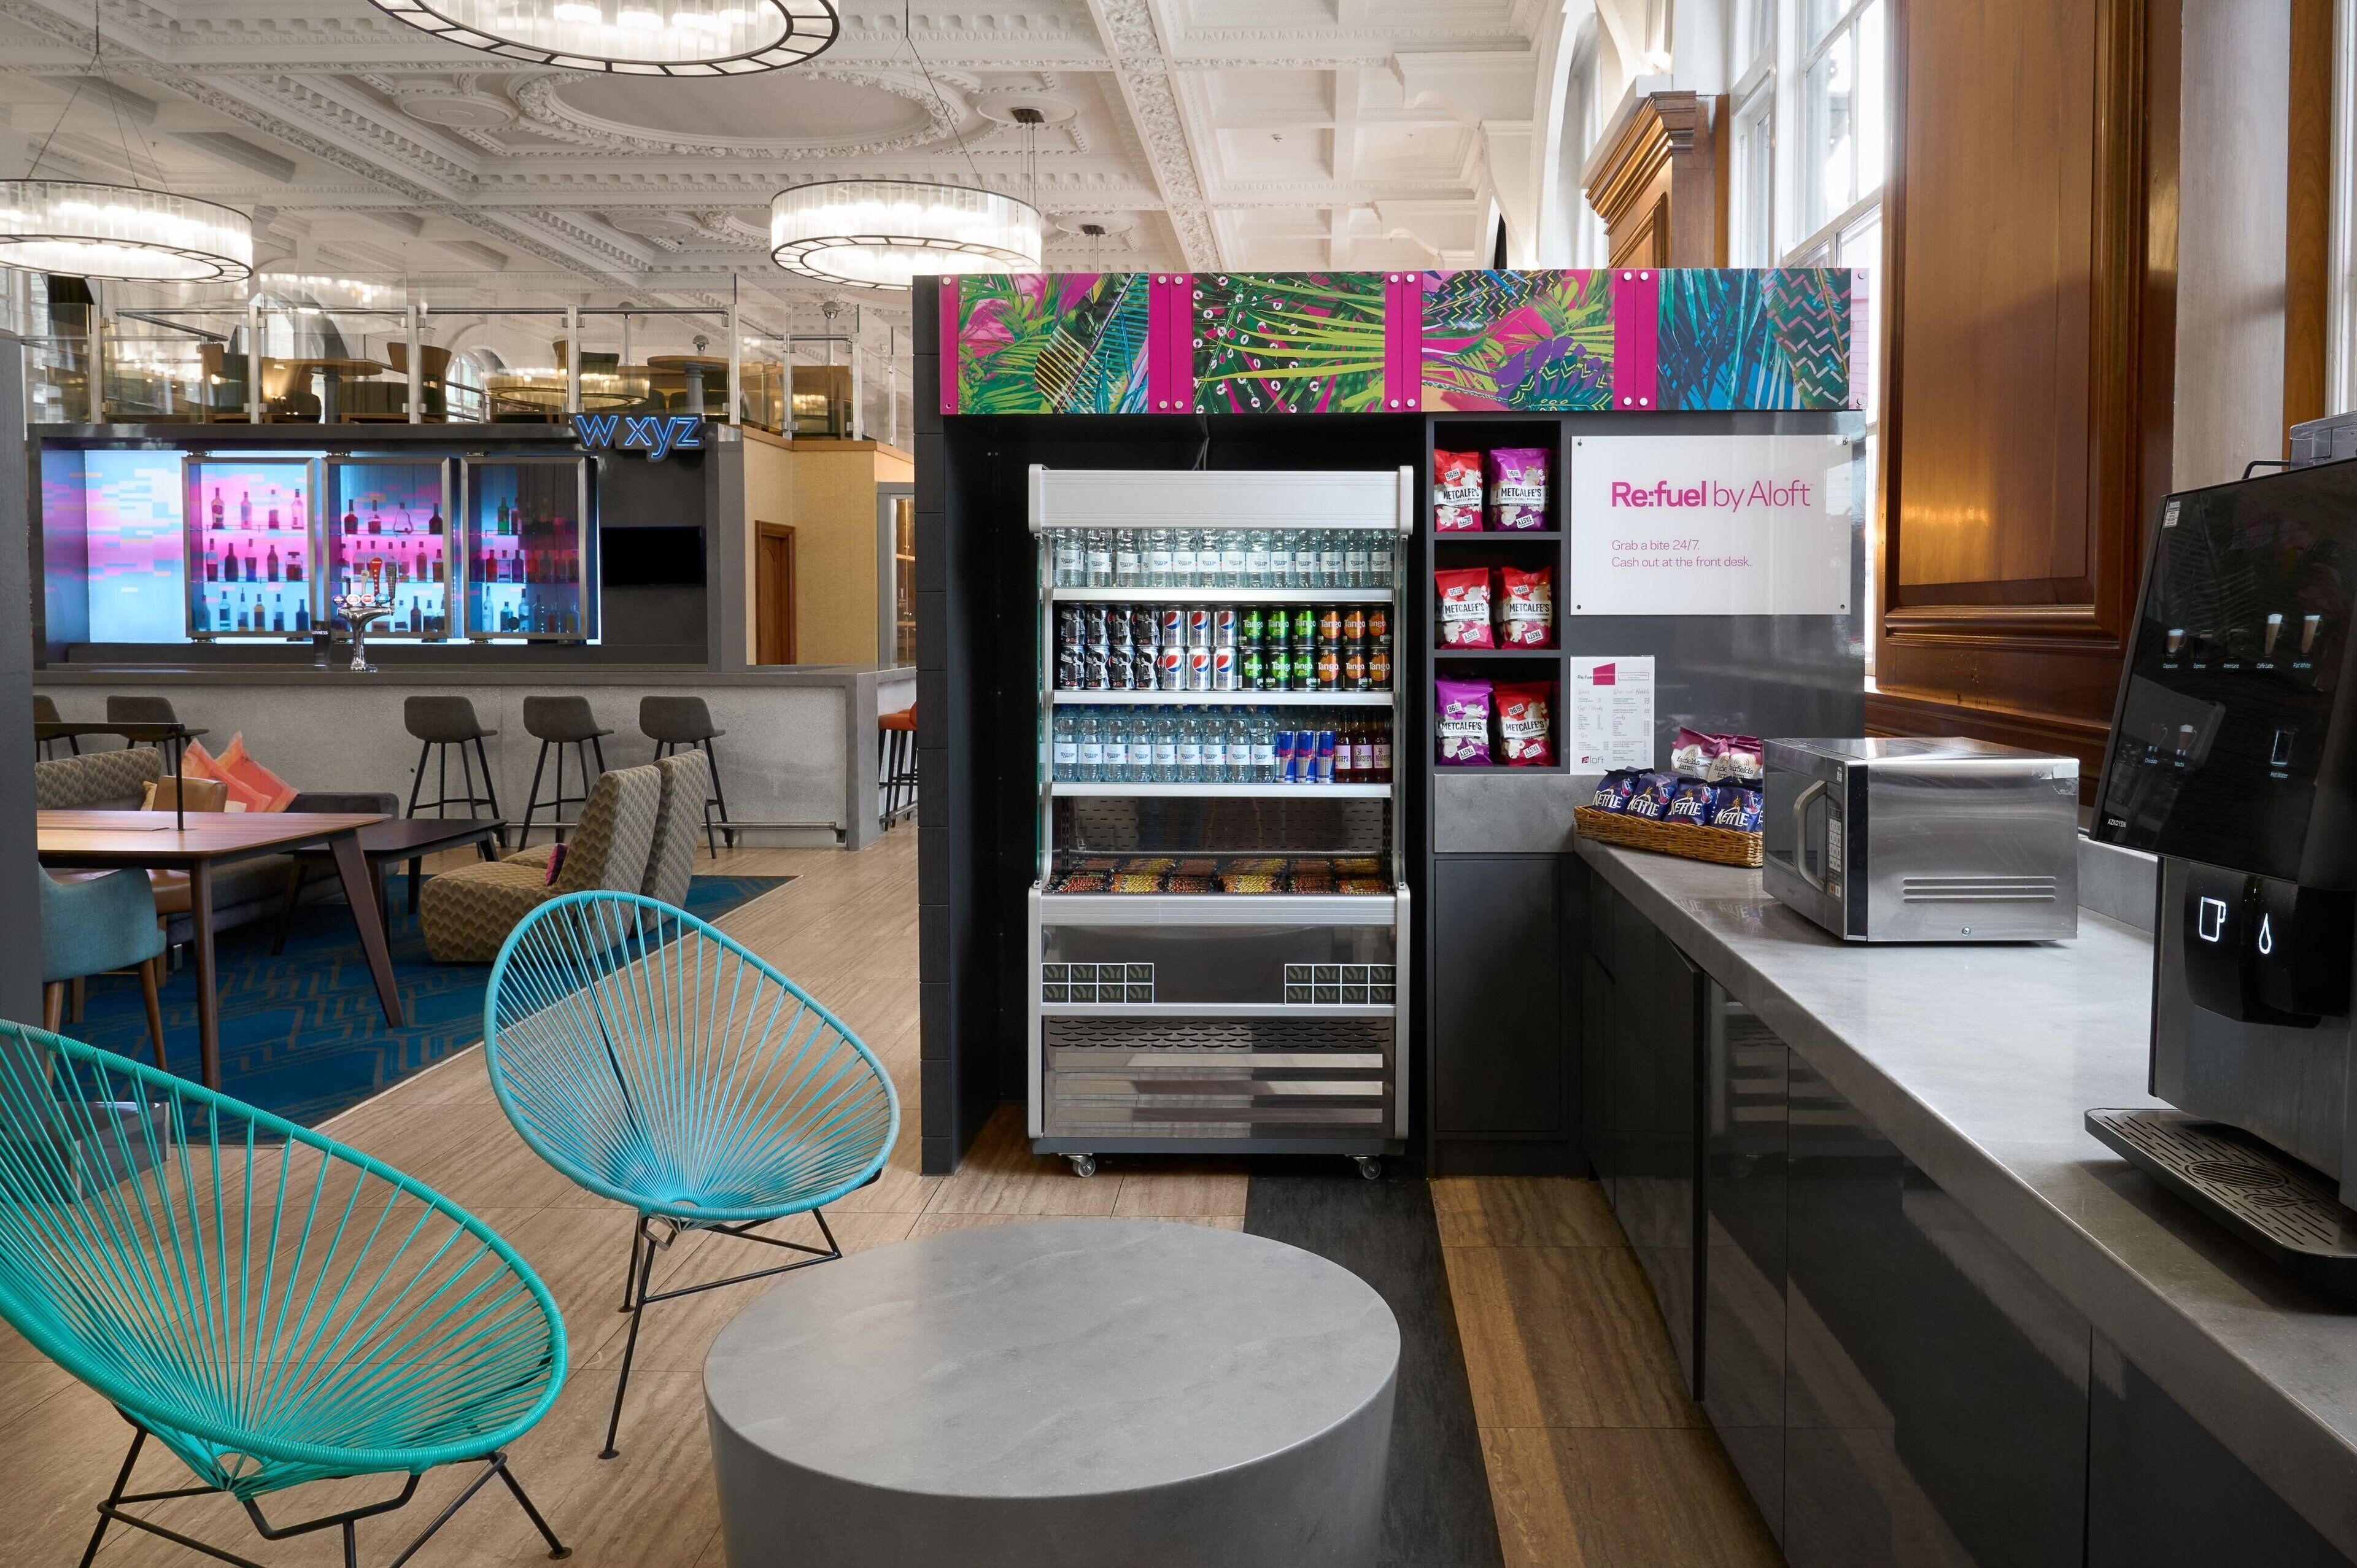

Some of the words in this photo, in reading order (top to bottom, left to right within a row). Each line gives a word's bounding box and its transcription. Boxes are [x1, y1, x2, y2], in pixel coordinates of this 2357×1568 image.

[1443, 487, 1479, 500] METCALFE'S
[1501, 488, 1542, 497] METCALFE'S
[1611, 481, 1706, 508] Re:fuel
[1713, 481, 1745, 512] by
[1747, 480, 1811, 507] Aloft
[1518, 516, 1532, 526] TASTY
[1611, 539, 1638, 550] Grab
[1651, 539, 1670, 550] bite
[1673, 539, 1700, 551] 24/7.
[1611, 557, 1639, 568] Cash
[1642, 558, 1659, 568] out
[1662, 558, 1673, 568] at
[1676, 557, 1692, 568] the
[1696, 556, 1721, 568] front
[1724, 556, 1752, 568] desk.
[1444, 603, 1484, 614] METCALFE'S
[1509, 603, 1550, 612] METCALFE'S
[1268, 619, 1289, 629] Tango
[1295, 619, 1316, 628] Tango
[1320, 619, 1342, 629] Tango
[1344, 619, 1366, 629] Tango
[1527, 631, 1541, 640] TASTY
[1318, 662, 1339, 671] Tango
[1369, 662, 1390, 671] Tango
[1441, 722, 1482, 730] METCALFE'S
[1506, 720, 1545, 732] METCALFE'S
[1460, 747, 1474, 757] TASTY
[1525, 745, 1539, 755] TASTY
[1679, 763, 1693, 771] farm
[1592, 789, 1622, 809] KETTLE
[1627, 794, 1660, 817] KETTLE
[1668, 797, 1702, 816] KETTLE
[1714, 806, 1749, 827] KETTLE
[2107, 818, 2127, 828] AZKOYEN
